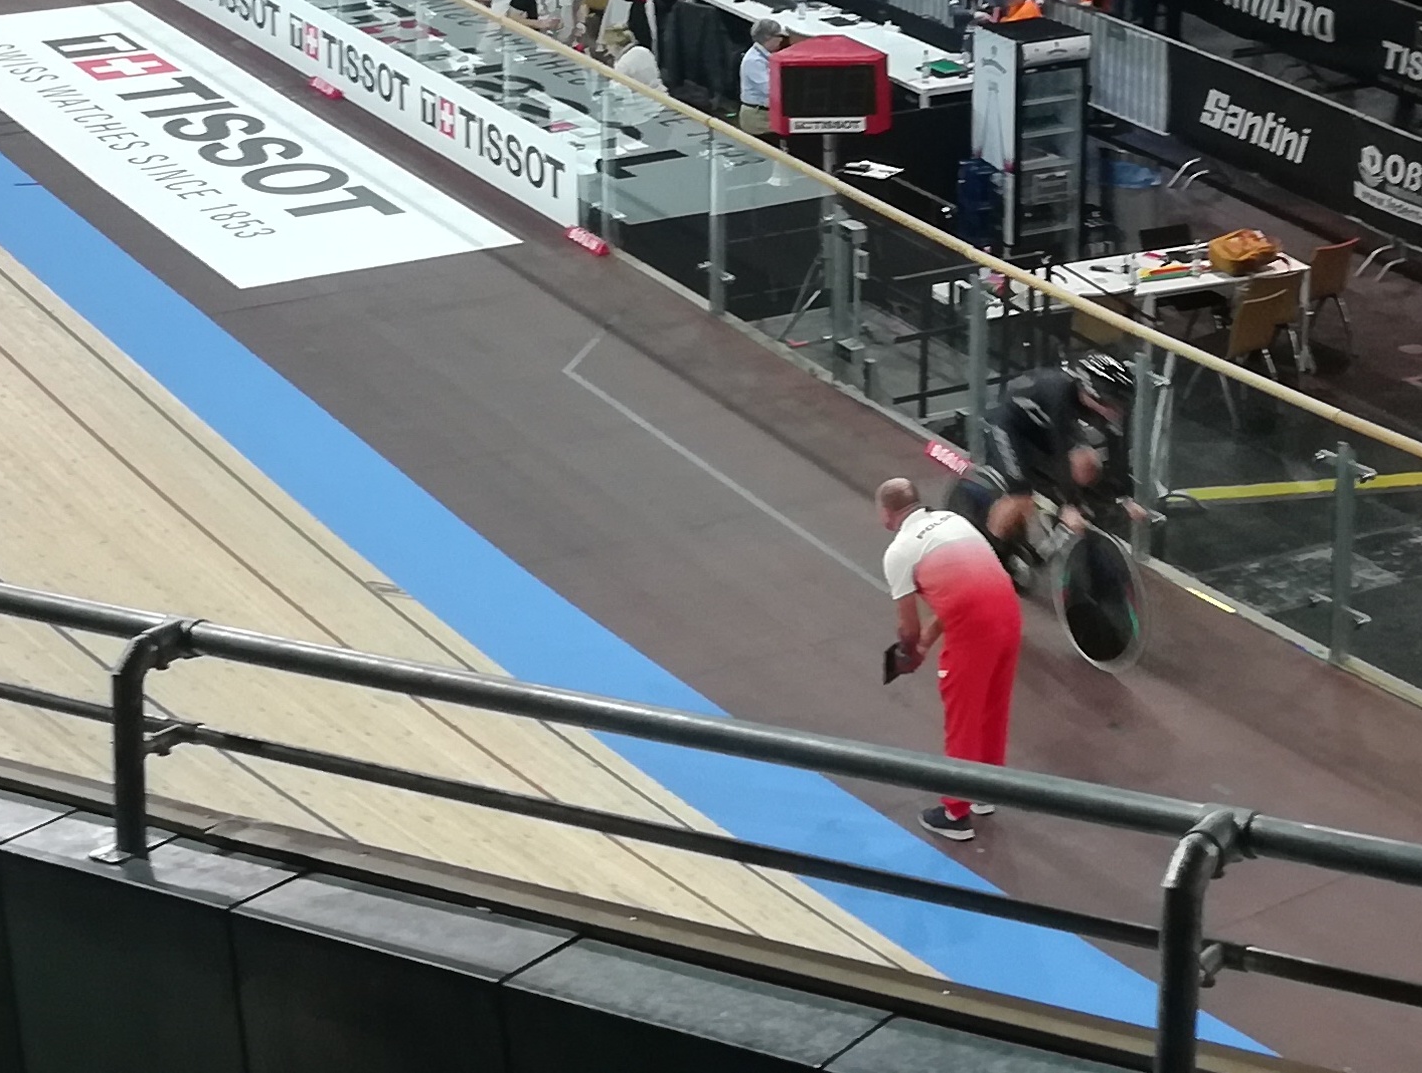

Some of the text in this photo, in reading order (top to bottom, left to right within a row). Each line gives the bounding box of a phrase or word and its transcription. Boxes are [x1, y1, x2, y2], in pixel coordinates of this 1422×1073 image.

[321, 31, 410, 112] TISSOT
[42, 84, 149, 153] WATCHES
[126, 152, 222, 203] SINCE
[199, 201, 277, 239] 1853
[116, 76, 406, 219] TISSOT
[453, 106, 567, 200] TISSOT
[1200, 88, 1312, 166] Santini
